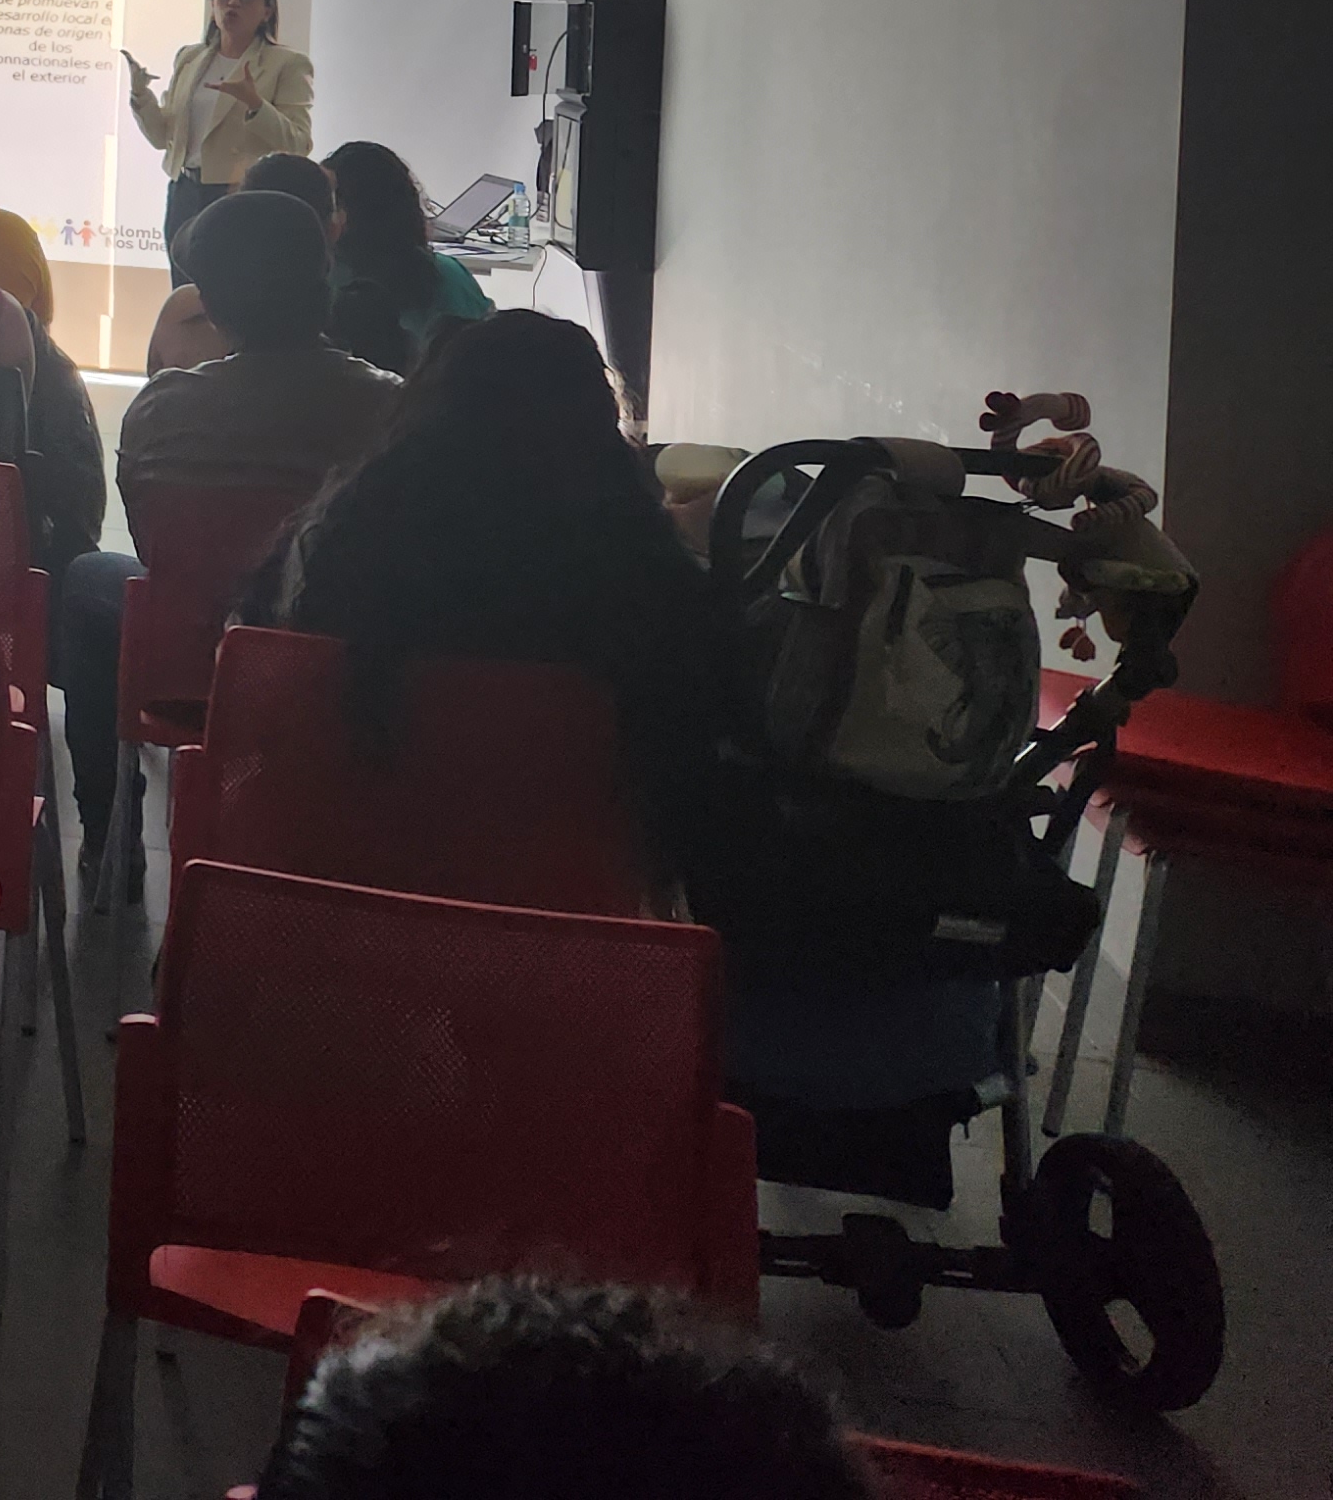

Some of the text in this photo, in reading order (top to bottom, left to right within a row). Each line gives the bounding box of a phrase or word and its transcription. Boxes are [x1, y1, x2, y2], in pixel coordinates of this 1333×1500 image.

[63, 11, 97, 25] local
[34, 24, 54, 38] de
[57, 28, 103, 41] origen
[28, 40, 73, 54] de los
[95, 61, 113, 71] en
[12, 70, 87, 85] el exterior
